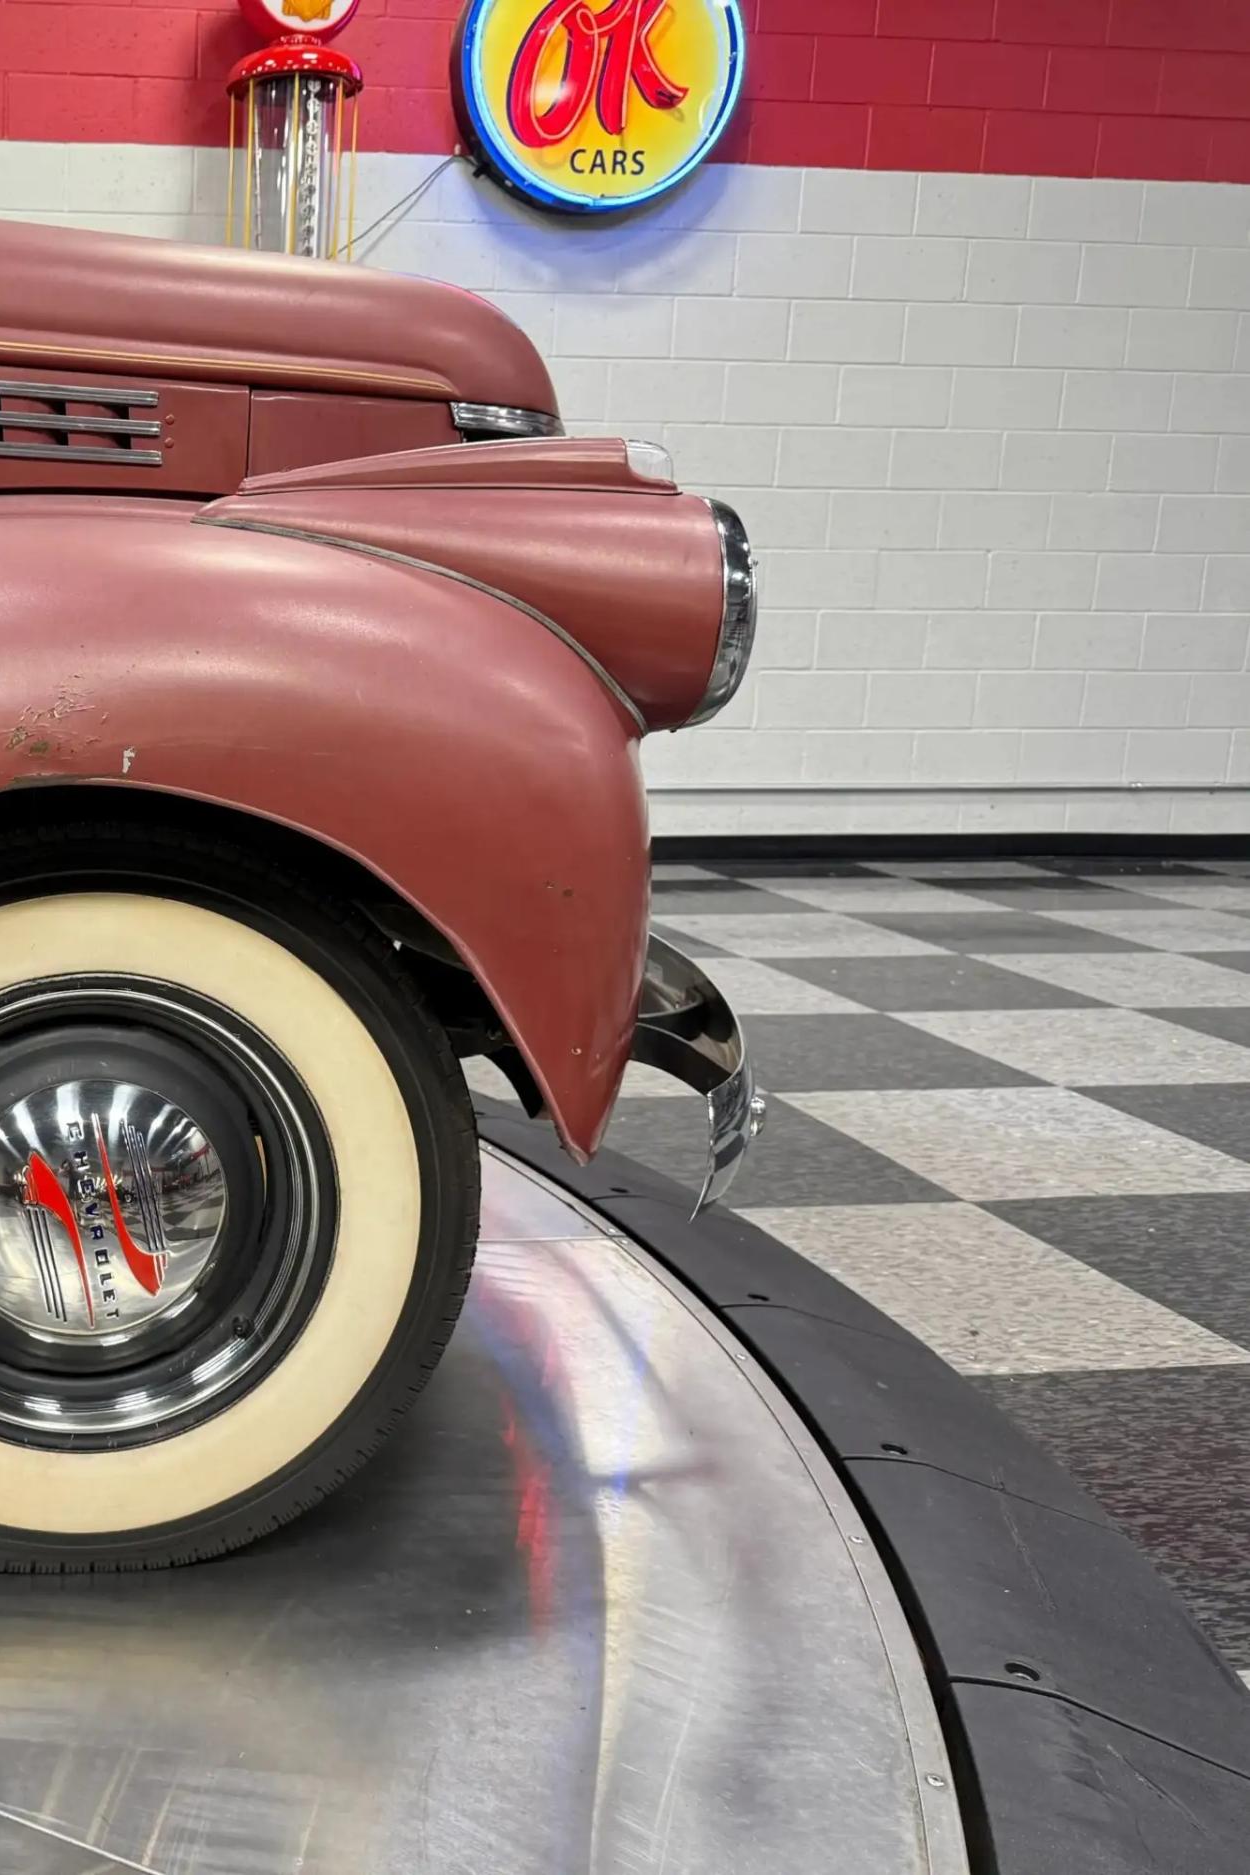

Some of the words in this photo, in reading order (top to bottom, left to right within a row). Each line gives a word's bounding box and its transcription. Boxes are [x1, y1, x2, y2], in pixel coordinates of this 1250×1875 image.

[506, 0, 690, 148] OK
[570, 149, 645, 175] CARS
[66, 1120, 120, 1320] CHEVROLET
